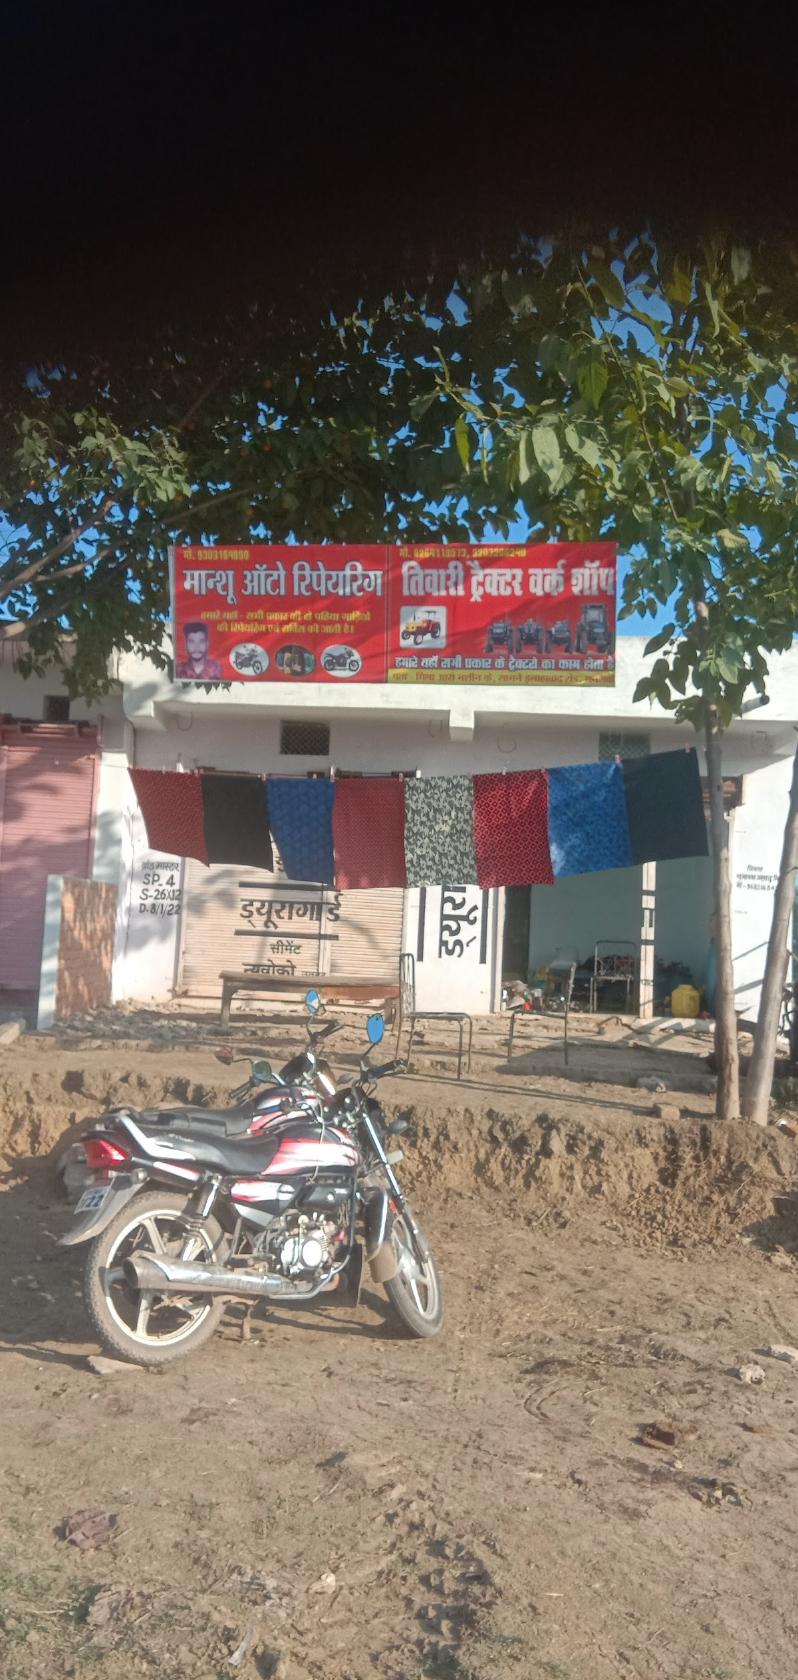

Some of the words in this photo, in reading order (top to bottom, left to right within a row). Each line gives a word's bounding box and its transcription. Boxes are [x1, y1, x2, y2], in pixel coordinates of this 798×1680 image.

[242, 561, 286, 597] ऑटो
[402, 560, 465, 597] तिवारी
[528, 559, 567, 597] वर्क
[270, 939, 302, 955] सीमेंट
